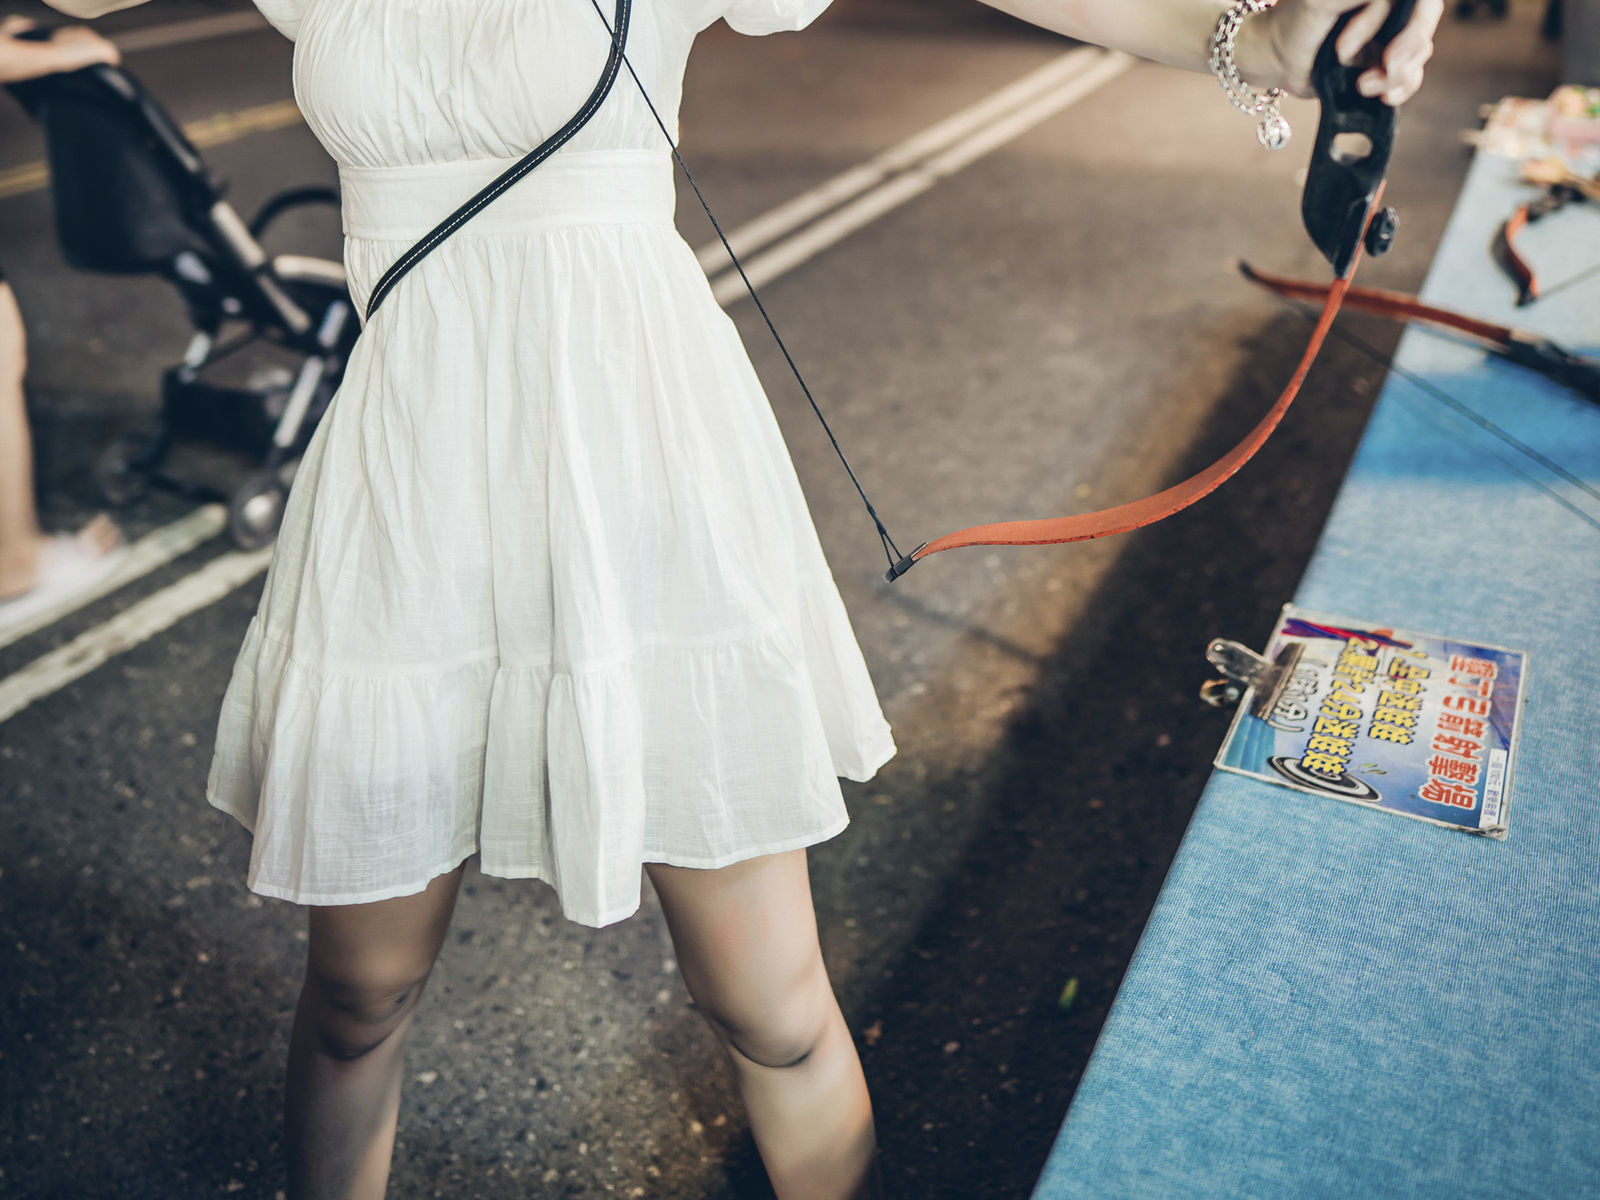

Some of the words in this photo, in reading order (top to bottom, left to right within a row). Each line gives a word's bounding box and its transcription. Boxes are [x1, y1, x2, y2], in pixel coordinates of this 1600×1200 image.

[1421, 654, 1496, 809] 墾丁弓箭射擊場
